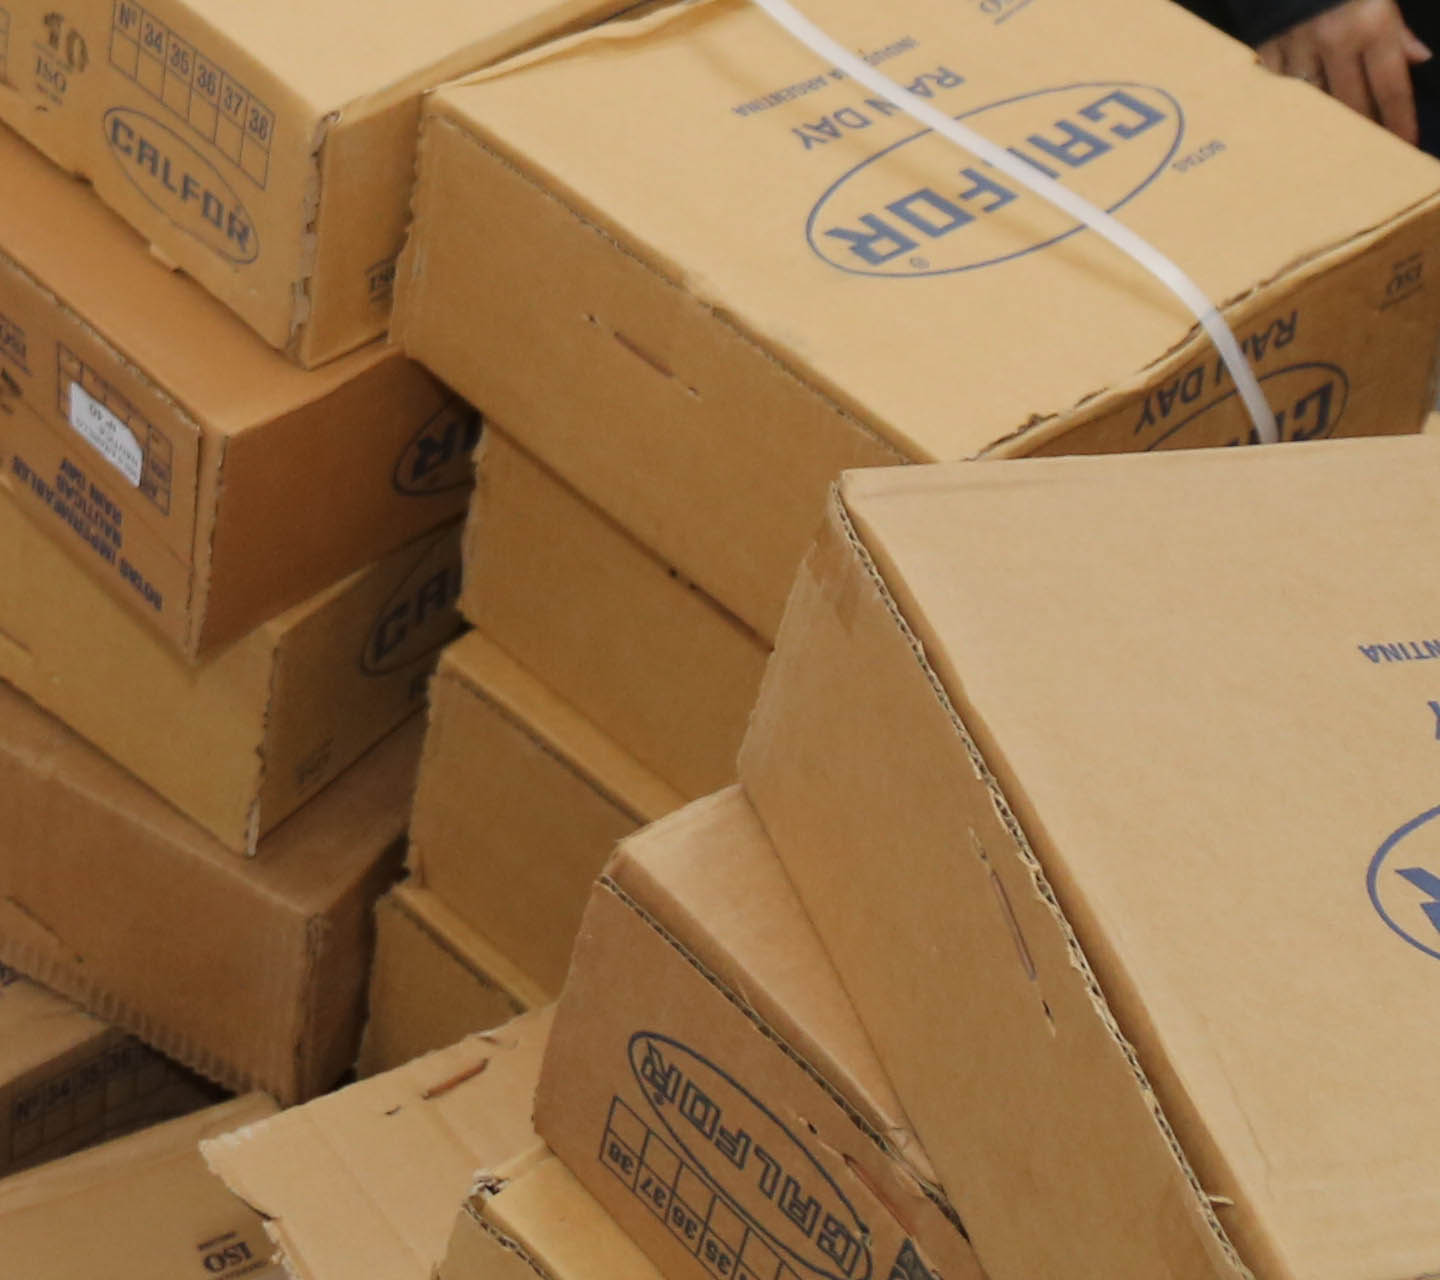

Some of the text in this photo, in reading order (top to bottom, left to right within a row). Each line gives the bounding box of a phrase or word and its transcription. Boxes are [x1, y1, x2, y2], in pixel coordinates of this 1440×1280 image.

[791, 107, 870, 148] DAY
[111, 118, 250, 253] CALFOR
[608, 1143, 634, 1176] 38
[643, 1041, 862, 1278] CALFOR
[640, 1178, 668, 1207] 37
[672, 1209, 698, 1240] 36
